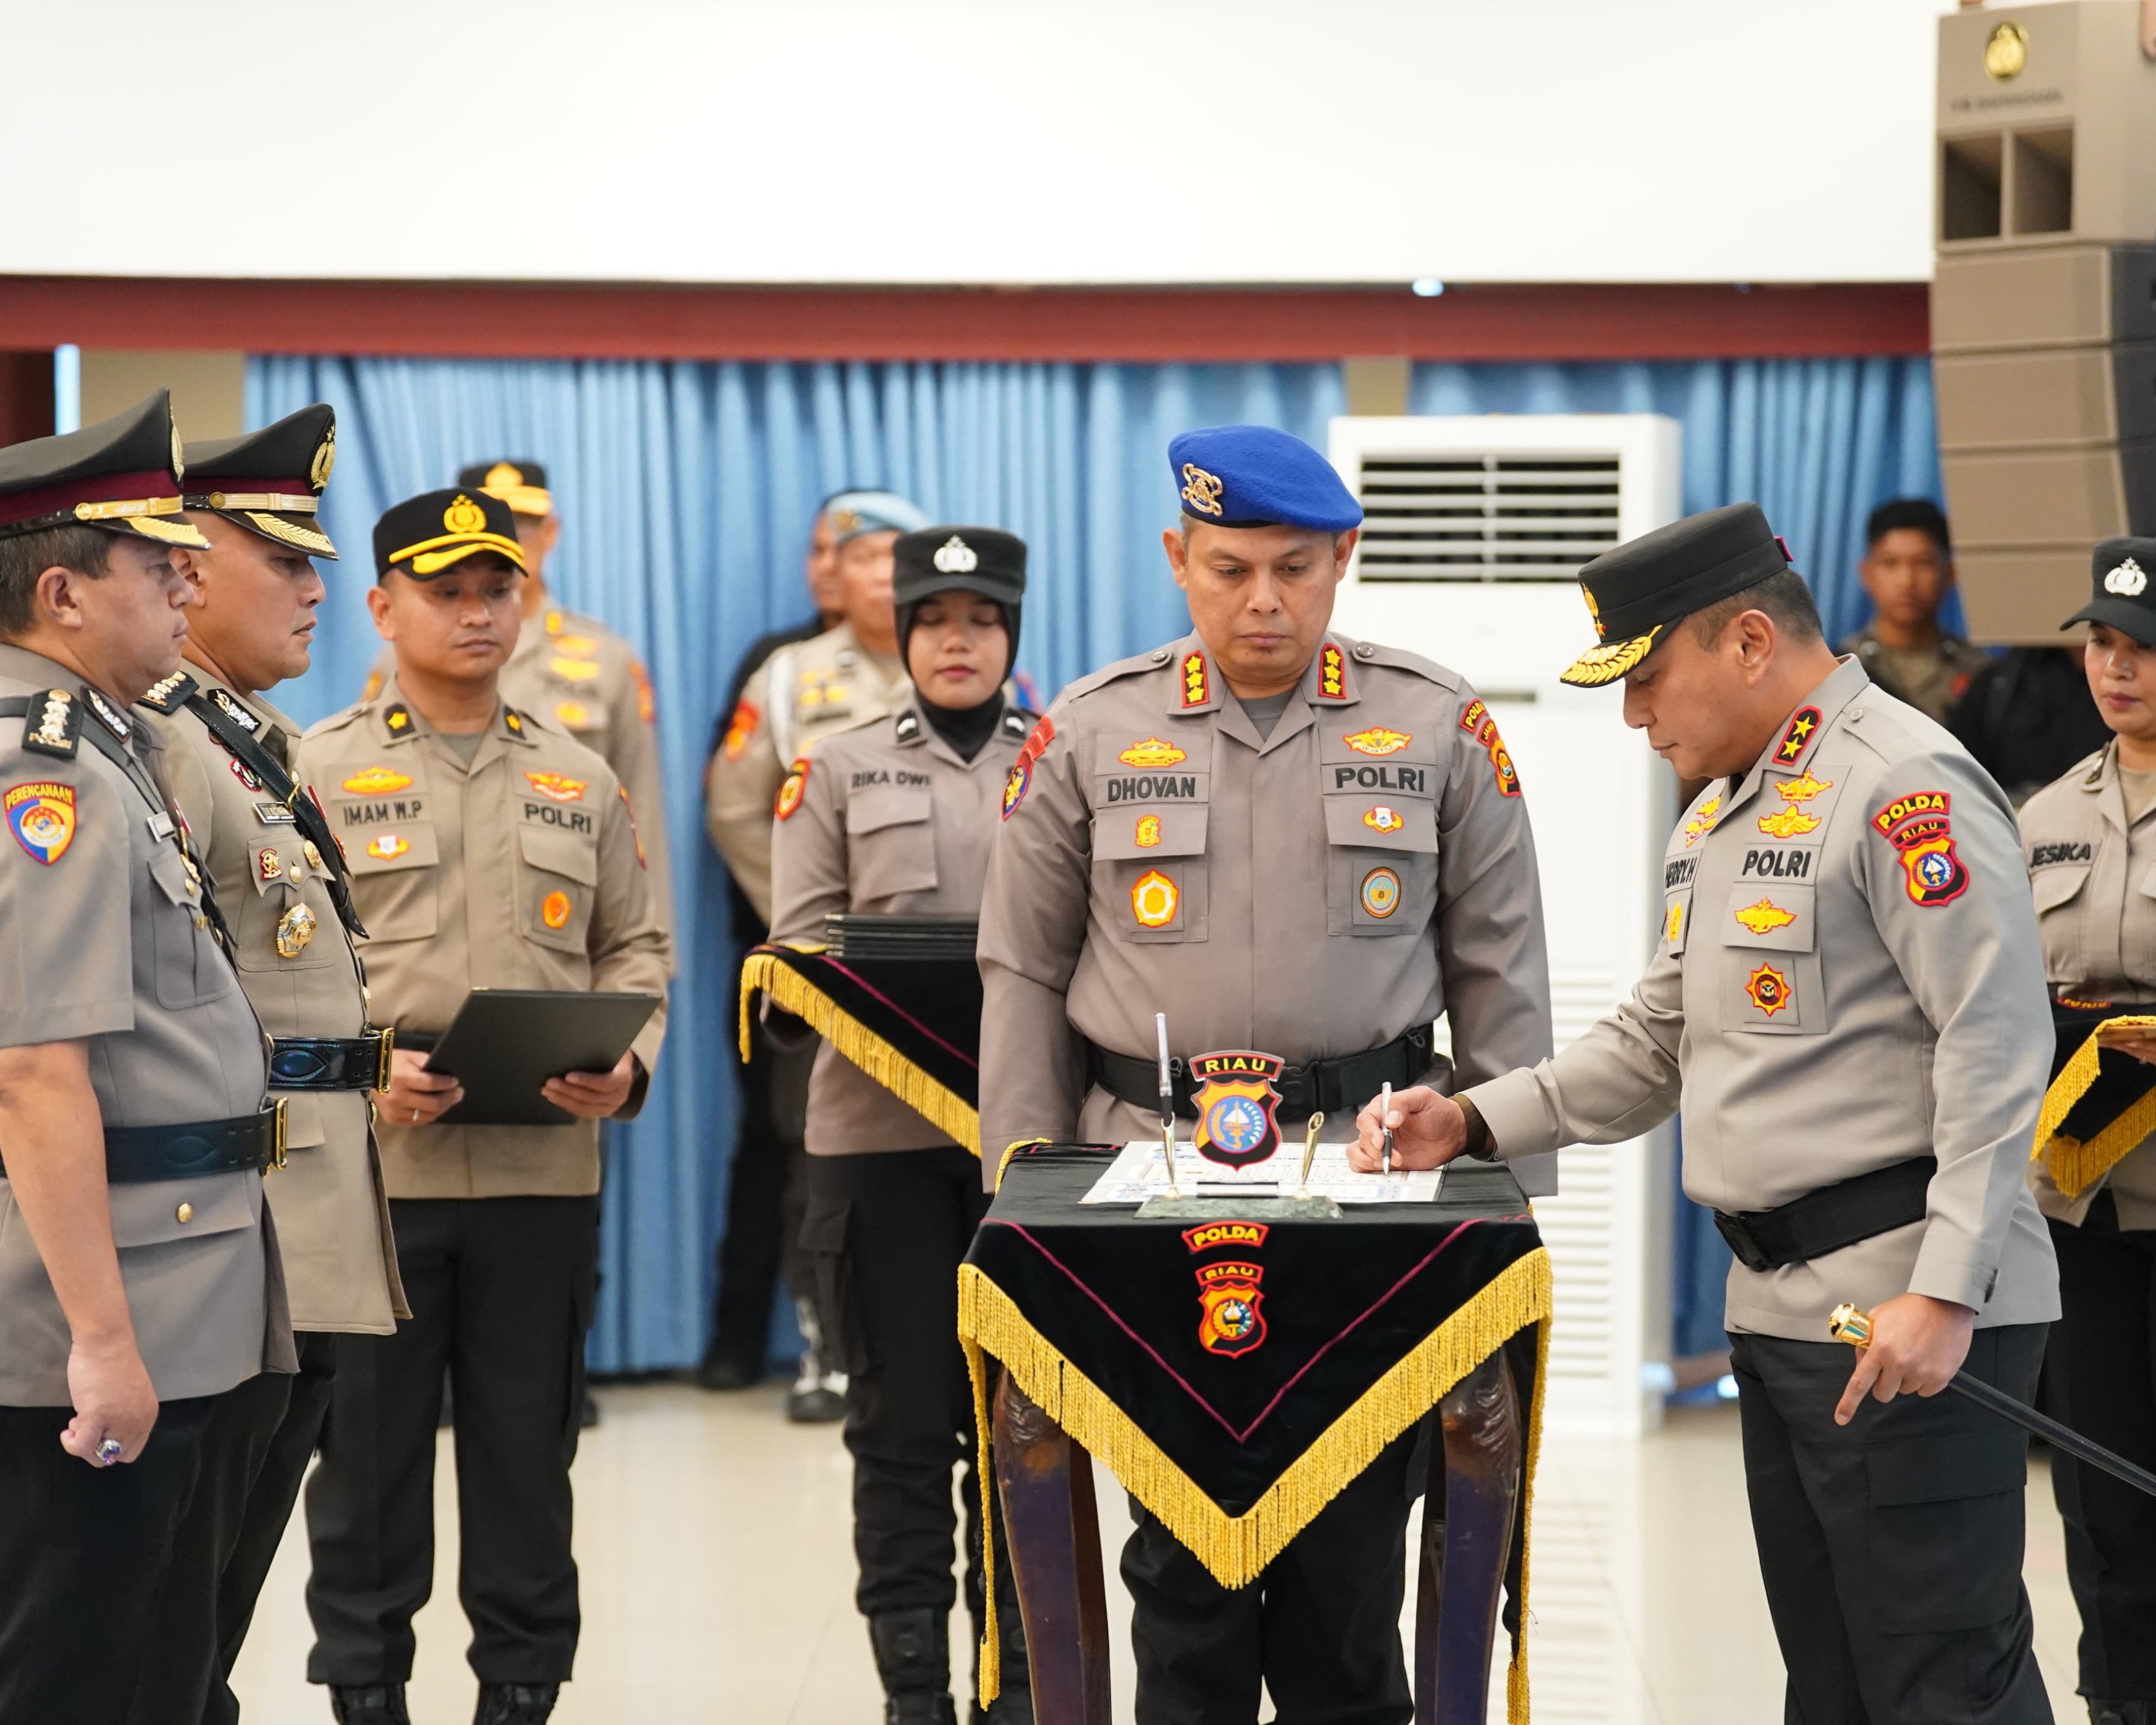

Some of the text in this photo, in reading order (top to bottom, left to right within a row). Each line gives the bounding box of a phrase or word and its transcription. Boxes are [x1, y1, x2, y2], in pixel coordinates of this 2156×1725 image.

[852, 770, 889, 789] RIKA
[1108, 776, 1196, 802] DHOVAN
[1335, 766, 1425, 792] POLRI
[5, 784, 73, 811] PERENCANAAN
[343, 802, 389, 826] IMAM
[524, 802, 591, 835] POLRI
[1878, 794, 1945, 830] POLDA
[1901, 821, 1938, 840] RIAU
[1742, 849, 1812, 878] POLRI
[2030, 842, 2091, 868] JESIKA
[1205, 1057, 1266, 1073] RIAU
[1193, 1226, 1259, 1247] POLDA
[1205, 1266, 1254, 1280] RIAU
